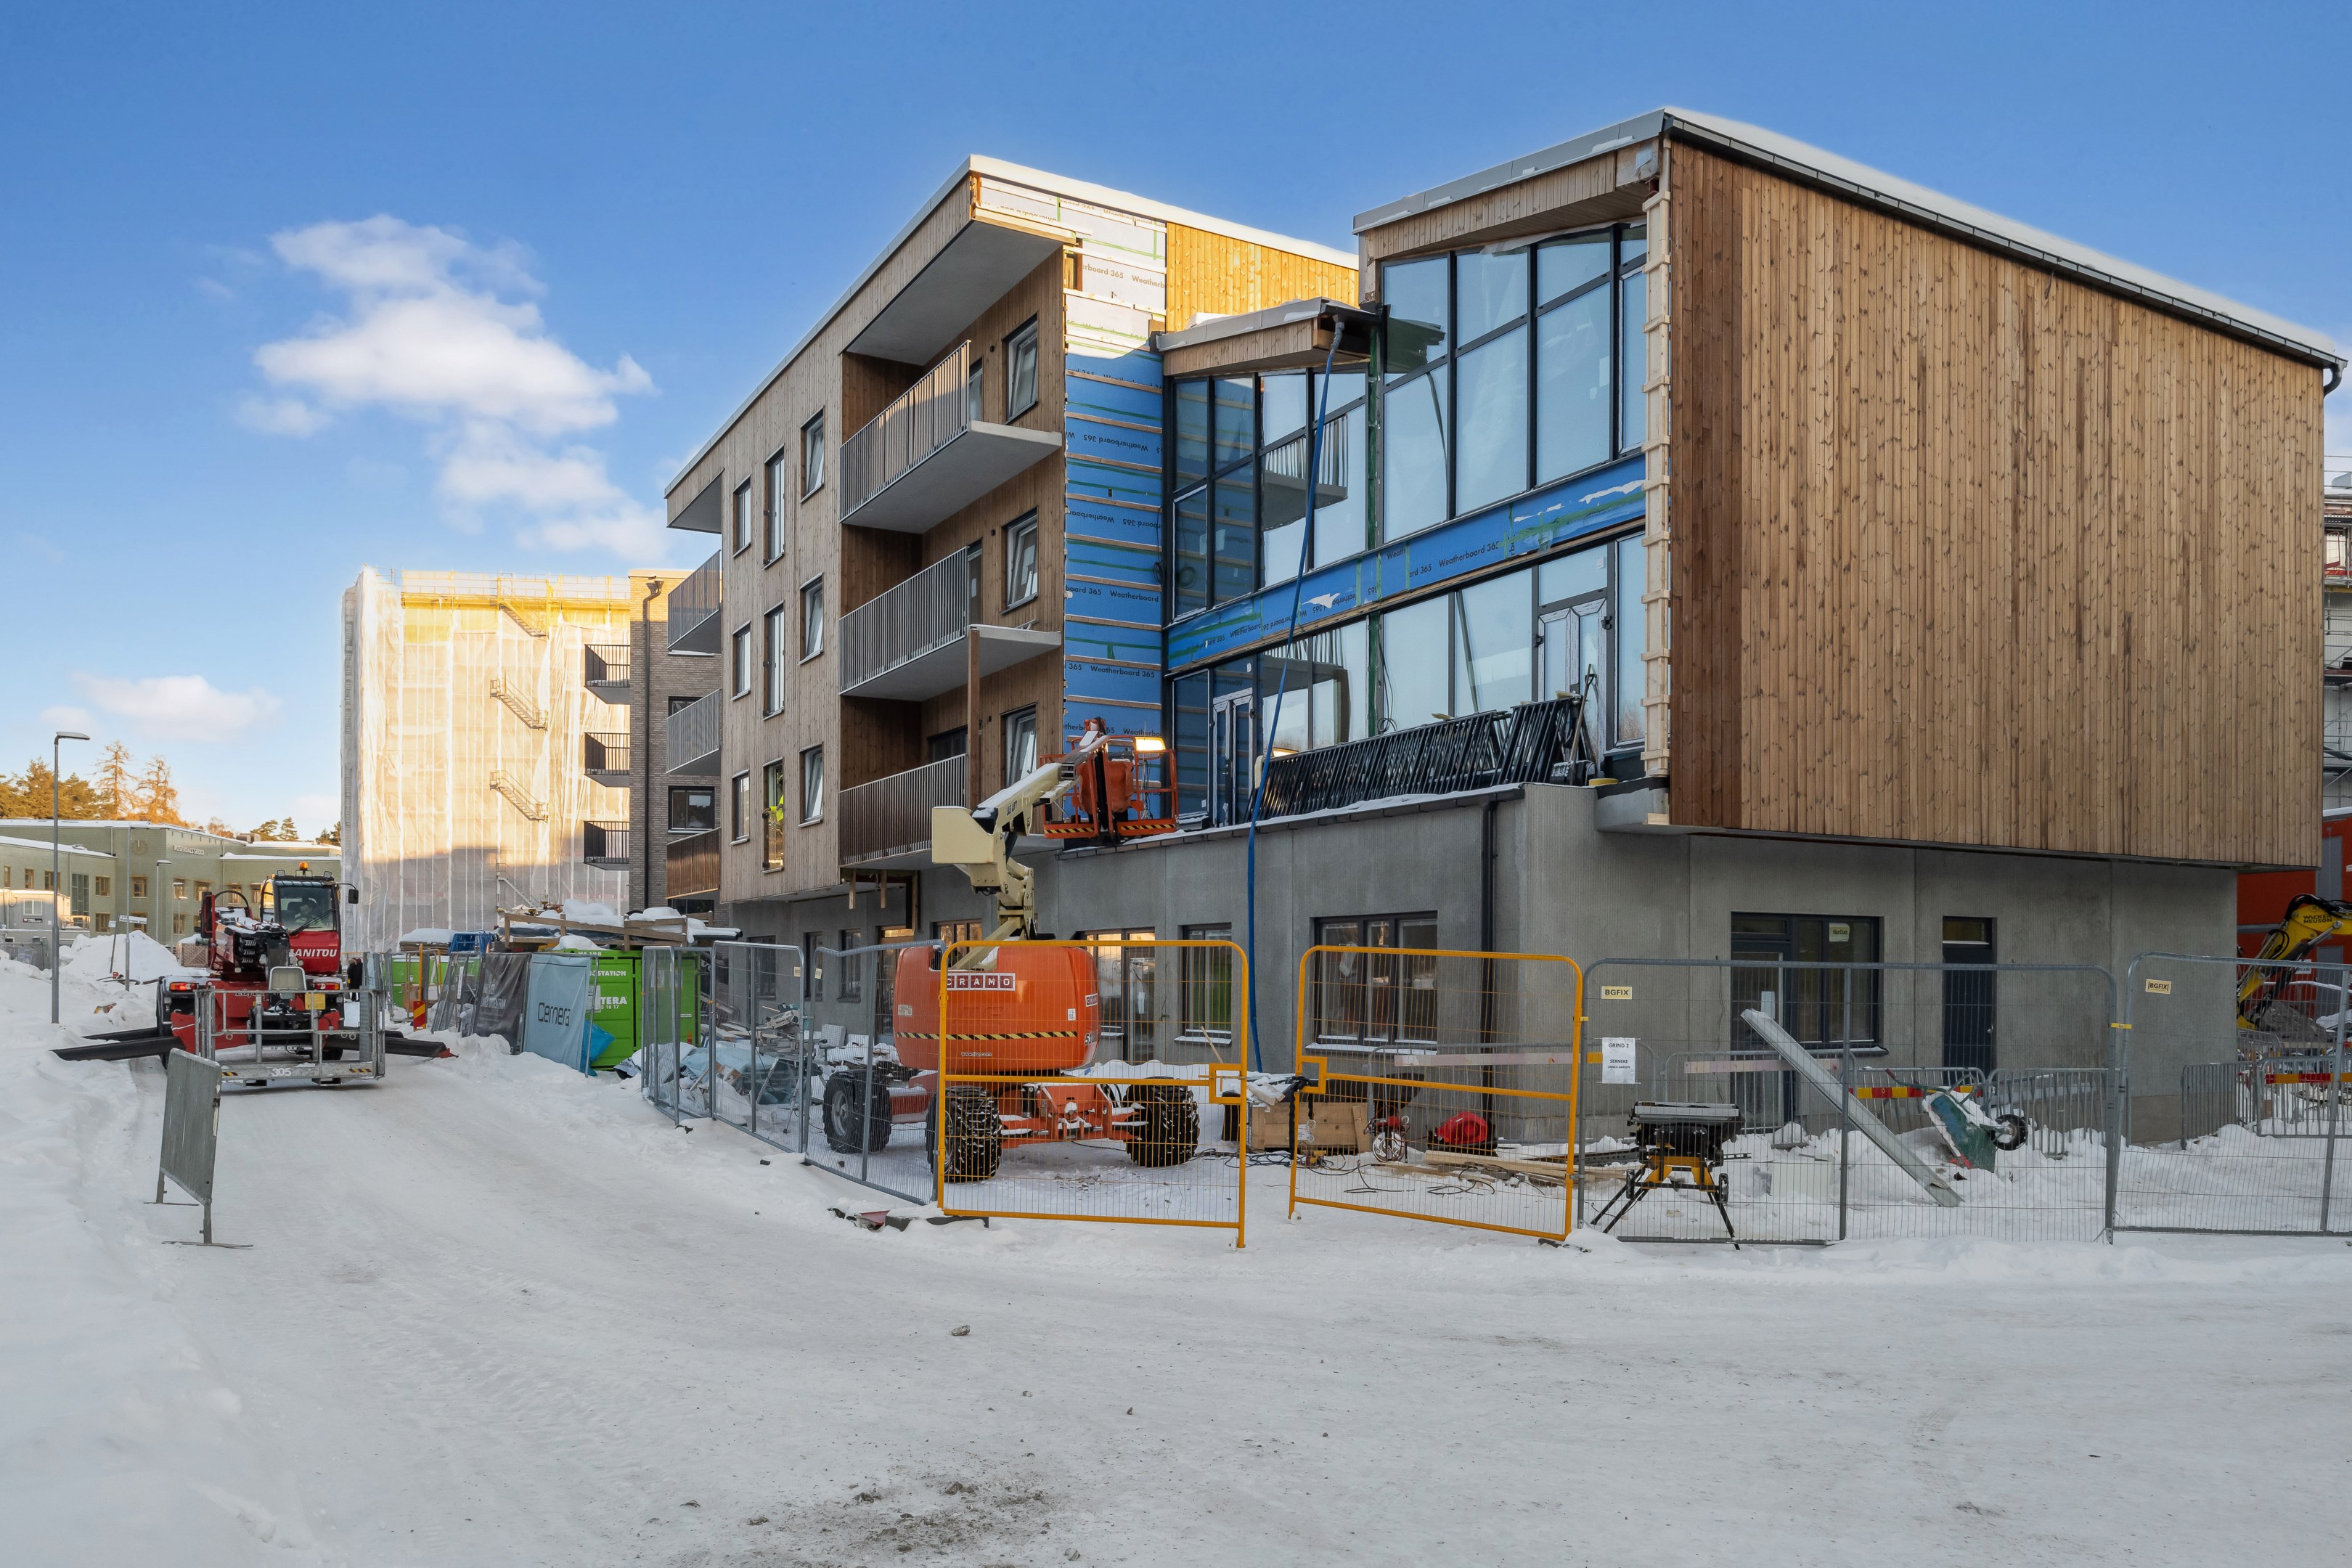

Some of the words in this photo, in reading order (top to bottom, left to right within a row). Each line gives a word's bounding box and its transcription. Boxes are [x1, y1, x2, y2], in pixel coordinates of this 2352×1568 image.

[1111, 269, 1124, 279] 365
[1083, 434, 1097, 443] 365
[1098, 437, 1148, 452] Weatherboard
[1420, 563, 1432, 574] 365
[1439, 544, 1485, 567] Weatherboard
[1110, 590, 1159, 603] Weatherboard
[1090, 665, 1140, 677] Weatherboard
[1141, 668, 1155, 678] 365
[538, 1002, 571, 1026] Cernera
[271, 1067, 292, 1077] 305
